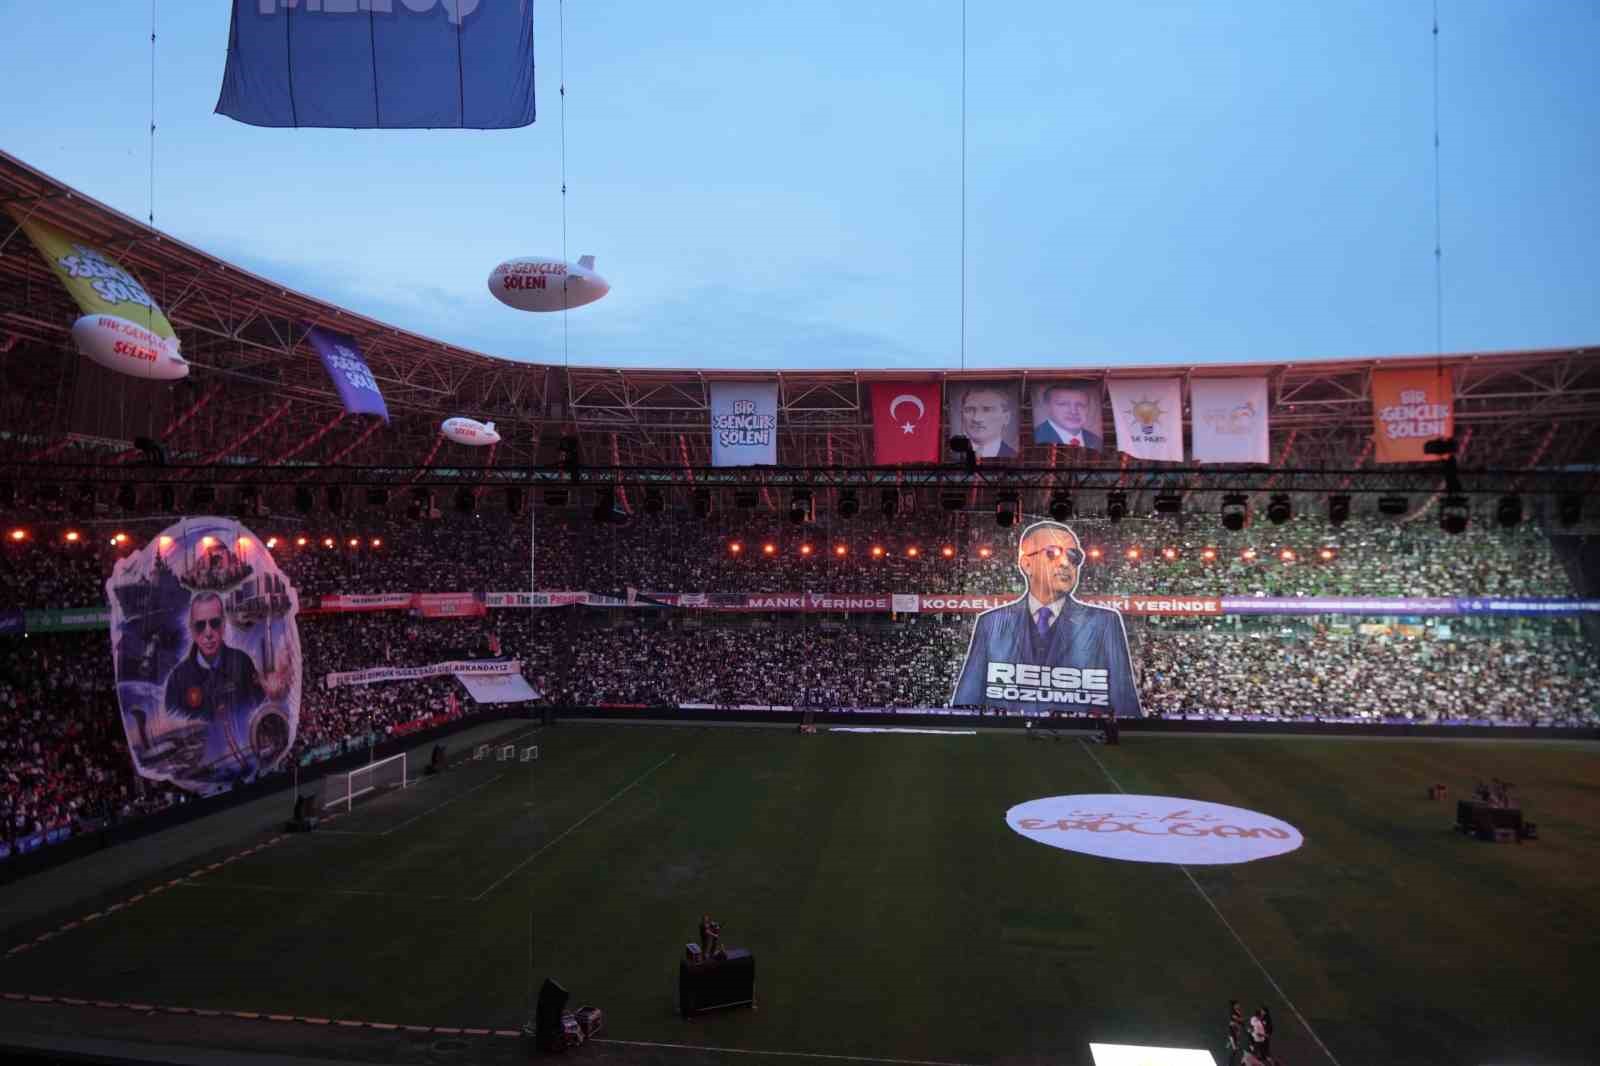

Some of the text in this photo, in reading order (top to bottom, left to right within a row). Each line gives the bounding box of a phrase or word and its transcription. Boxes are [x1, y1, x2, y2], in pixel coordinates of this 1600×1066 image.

[811, 596, 886, 609] YERİNDE
[1134, 599, 1216, 611] YERİNDE
[986, 684, 1108, 705] SÖZÜMÜZ
